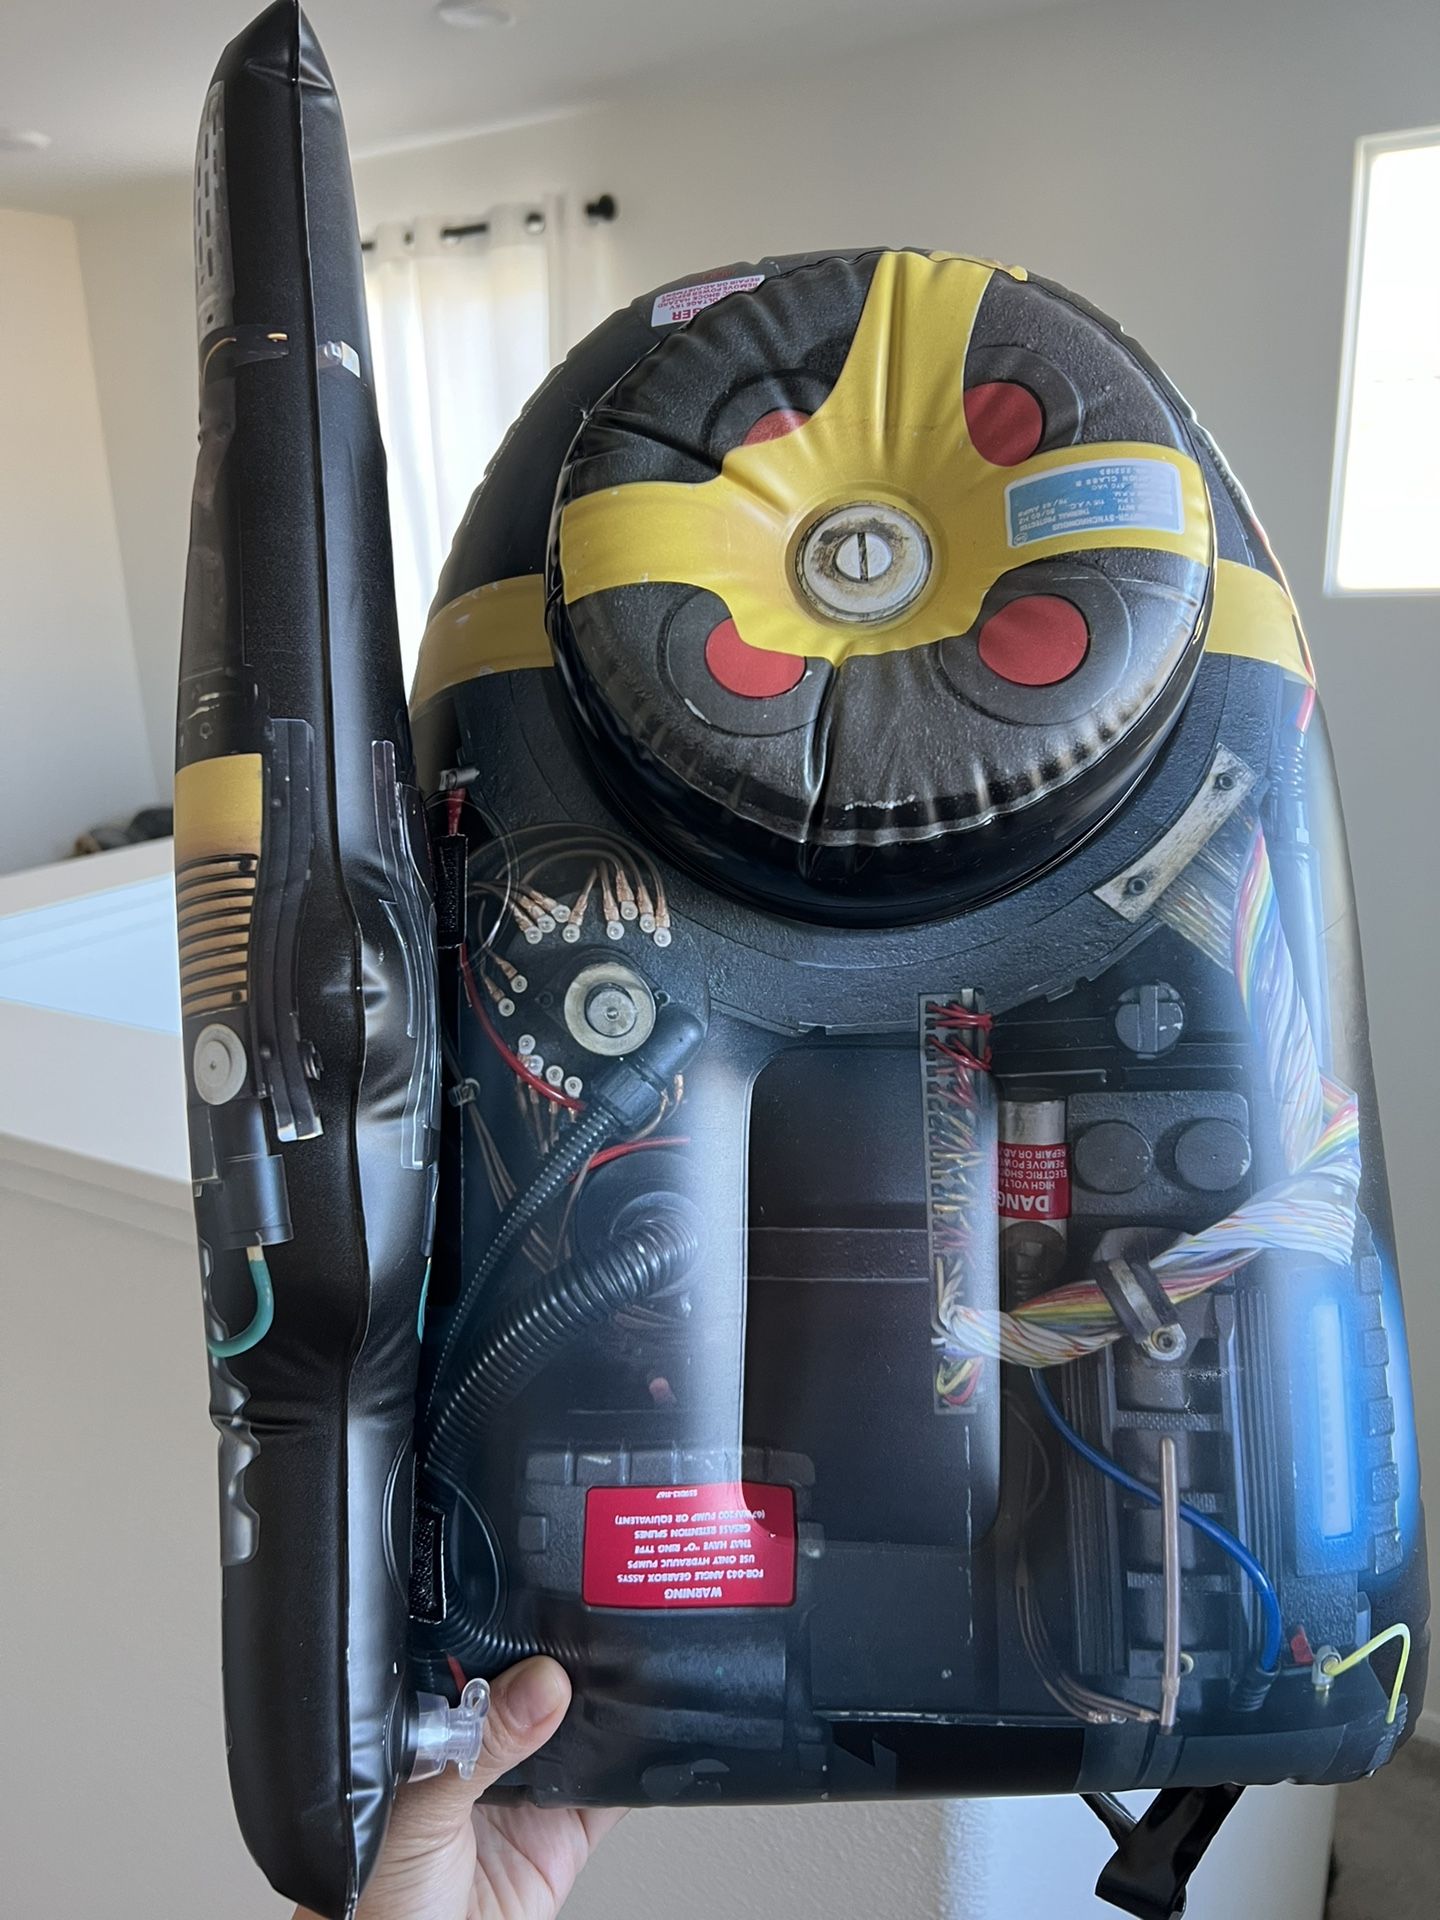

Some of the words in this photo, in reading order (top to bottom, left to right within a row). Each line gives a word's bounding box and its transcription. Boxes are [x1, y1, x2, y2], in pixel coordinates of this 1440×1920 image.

[1018, 1150, 1033, 1158] OR
[1035, 1148, 1066, 1158] REPAIR
[1026, 1159, 1065, 1169] REMOVE
[1025, 1168, 1068, 1179] ELECTRIC
[1031, 1180, 1056, 1190] HIGH
[615, 1514, 673, 1525] EQUIVALENT)
[675, 1514, 689, 1522] OR
[691, 1511, 717, 1522] PUMP
[634, 1529, 668, 1539] SPLINES
[670, 1526, 717, 1538] RETENTION
[657, 1544, 681, 1553] RING
[703, 1540, 727, 1550] HAVE
[729, 1539, 752, 1549] THAT
[634, 1545, 655, 1554] TYPE
[660, 1557, 710, 1567] HYDRAULIC
[712, 1555, 736, 1565] ONLY
[739, 1554, 755, 1564] USE
[627, 1560, 658, 1569] PUMPS
[616, 1573, 645, 1583] ASSYS
[647, 1572, 692, 1582] GEARBOX
[694, 1570, 724, 1581] ANGLE
[664, 1586, 722, 1600] WARNING
